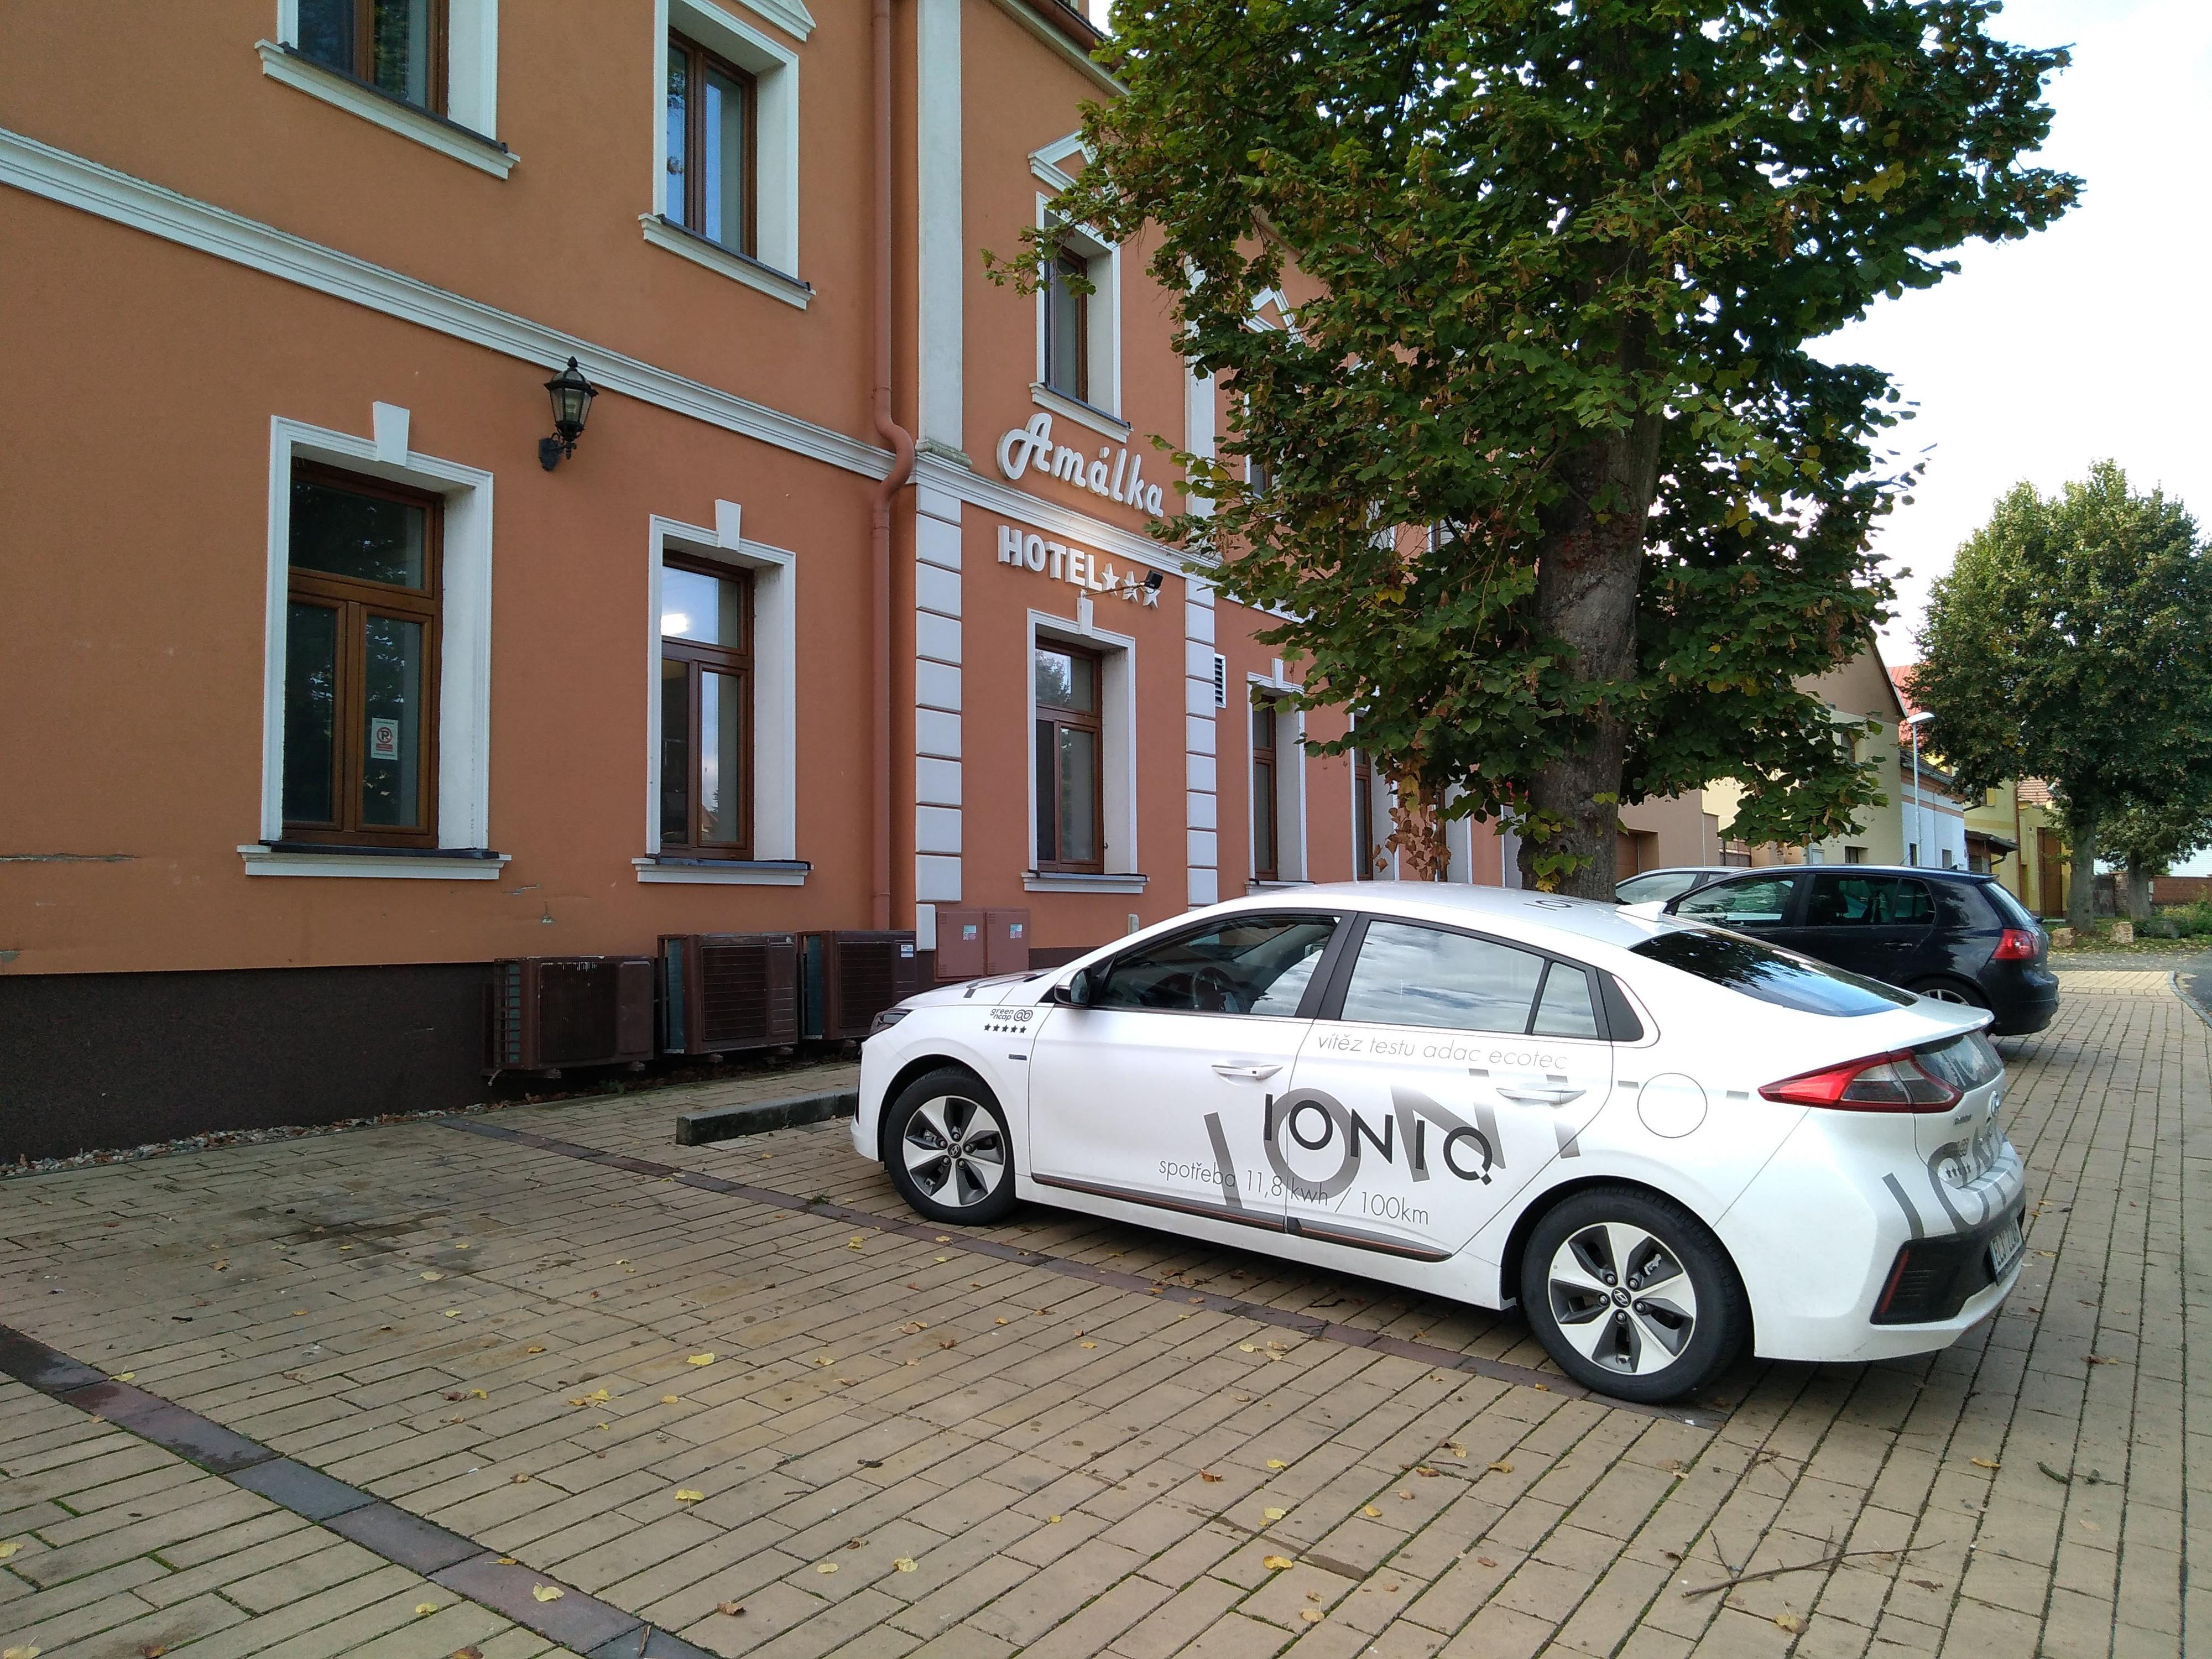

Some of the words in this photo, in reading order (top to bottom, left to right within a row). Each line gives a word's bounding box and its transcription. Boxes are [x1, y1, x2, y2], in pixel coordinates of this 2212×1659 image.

[998, 413, 1164, 518] Amálka
[998, 525, 1103, 591] HOTEL
[1319, 1033, 1363, 1052] vítěz
[1370, 1037, 1415, 1056] testu
[1423, 1040, 1480, 1062] adac
[1489, 1051, 1567, 1069] ecotec
[1263, 1093, 1493, 1186] IONIQ
[1159, 1160, 1235, 1188] spotřeba
[1247, 1170, 1282, 1198] 11,8
[1291, 1176, 1327, 1206] kwh
[1362, 1191, 1428, 1225] 100km
